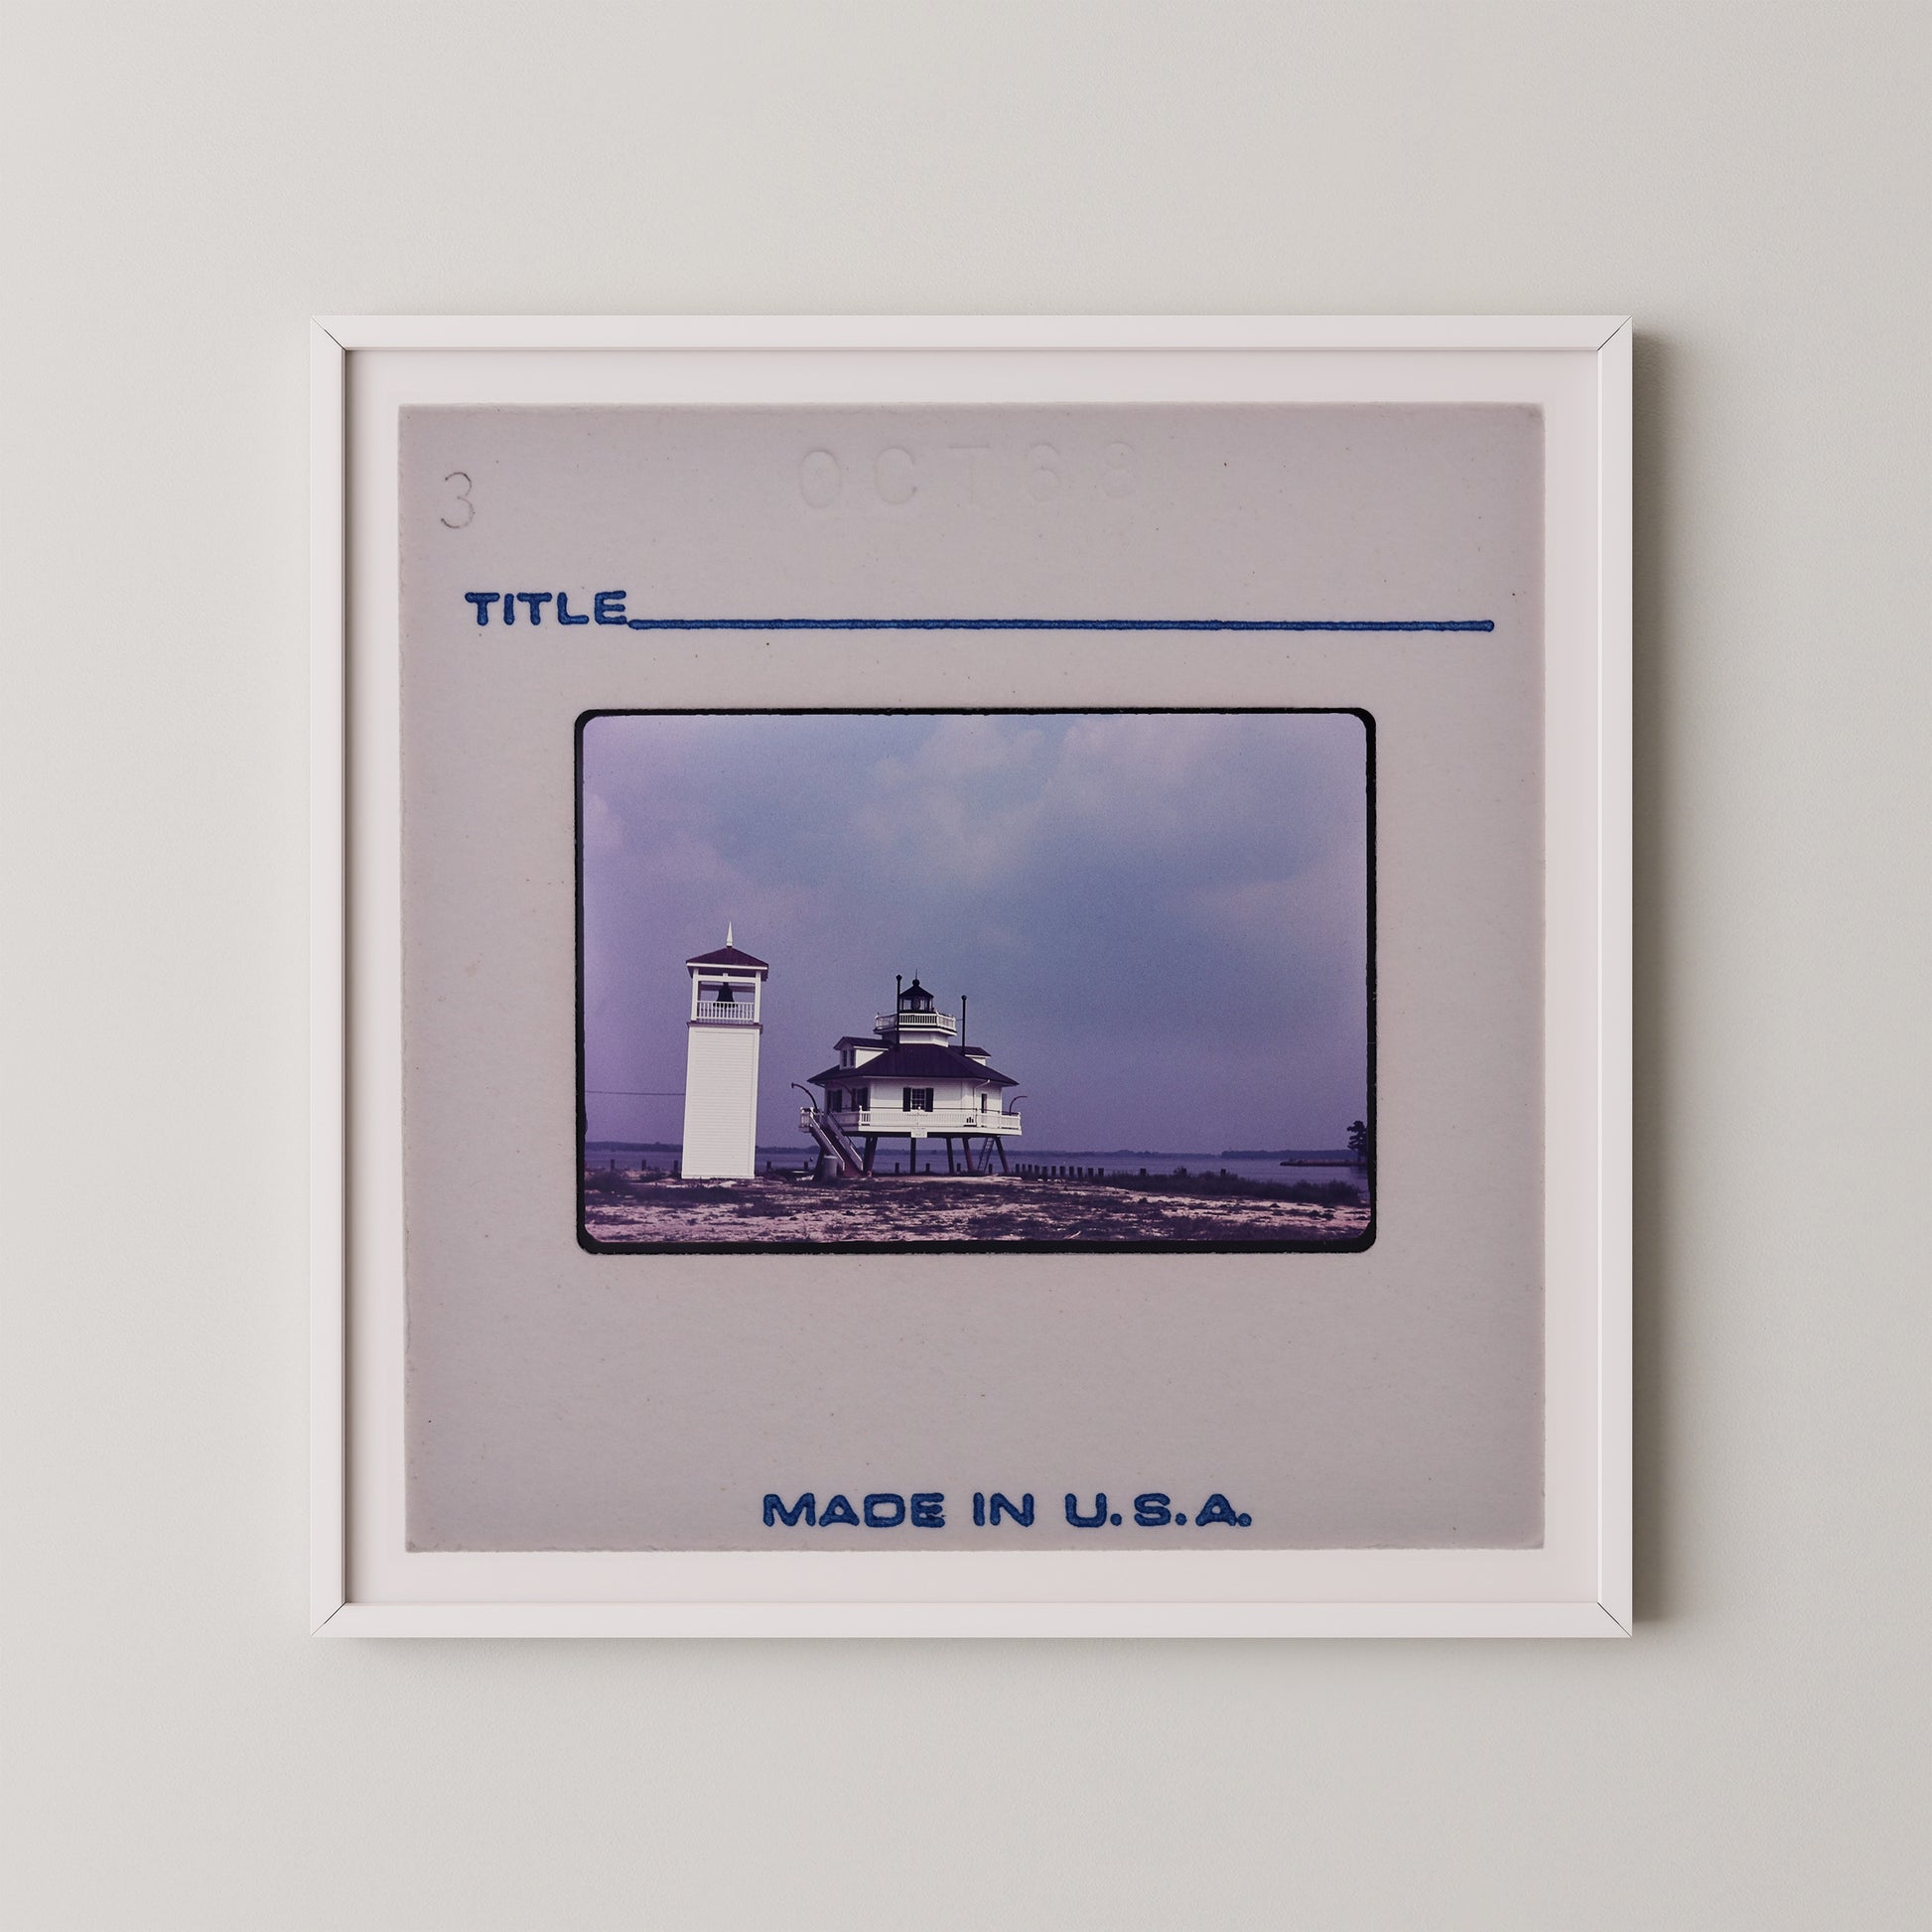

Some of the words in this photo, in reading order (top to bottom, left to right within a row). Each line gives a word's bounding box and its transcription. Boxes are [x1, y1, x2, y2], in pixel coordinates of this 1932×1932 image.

[441, 472, 475, 529] 3
[465, 591, 627, 626] TITLE
[762, 1492, 946, 1529] MADE
[972, 1492, 1035, 1529] IN
[1063, 1492, 1253, 1529] U.S.A.
